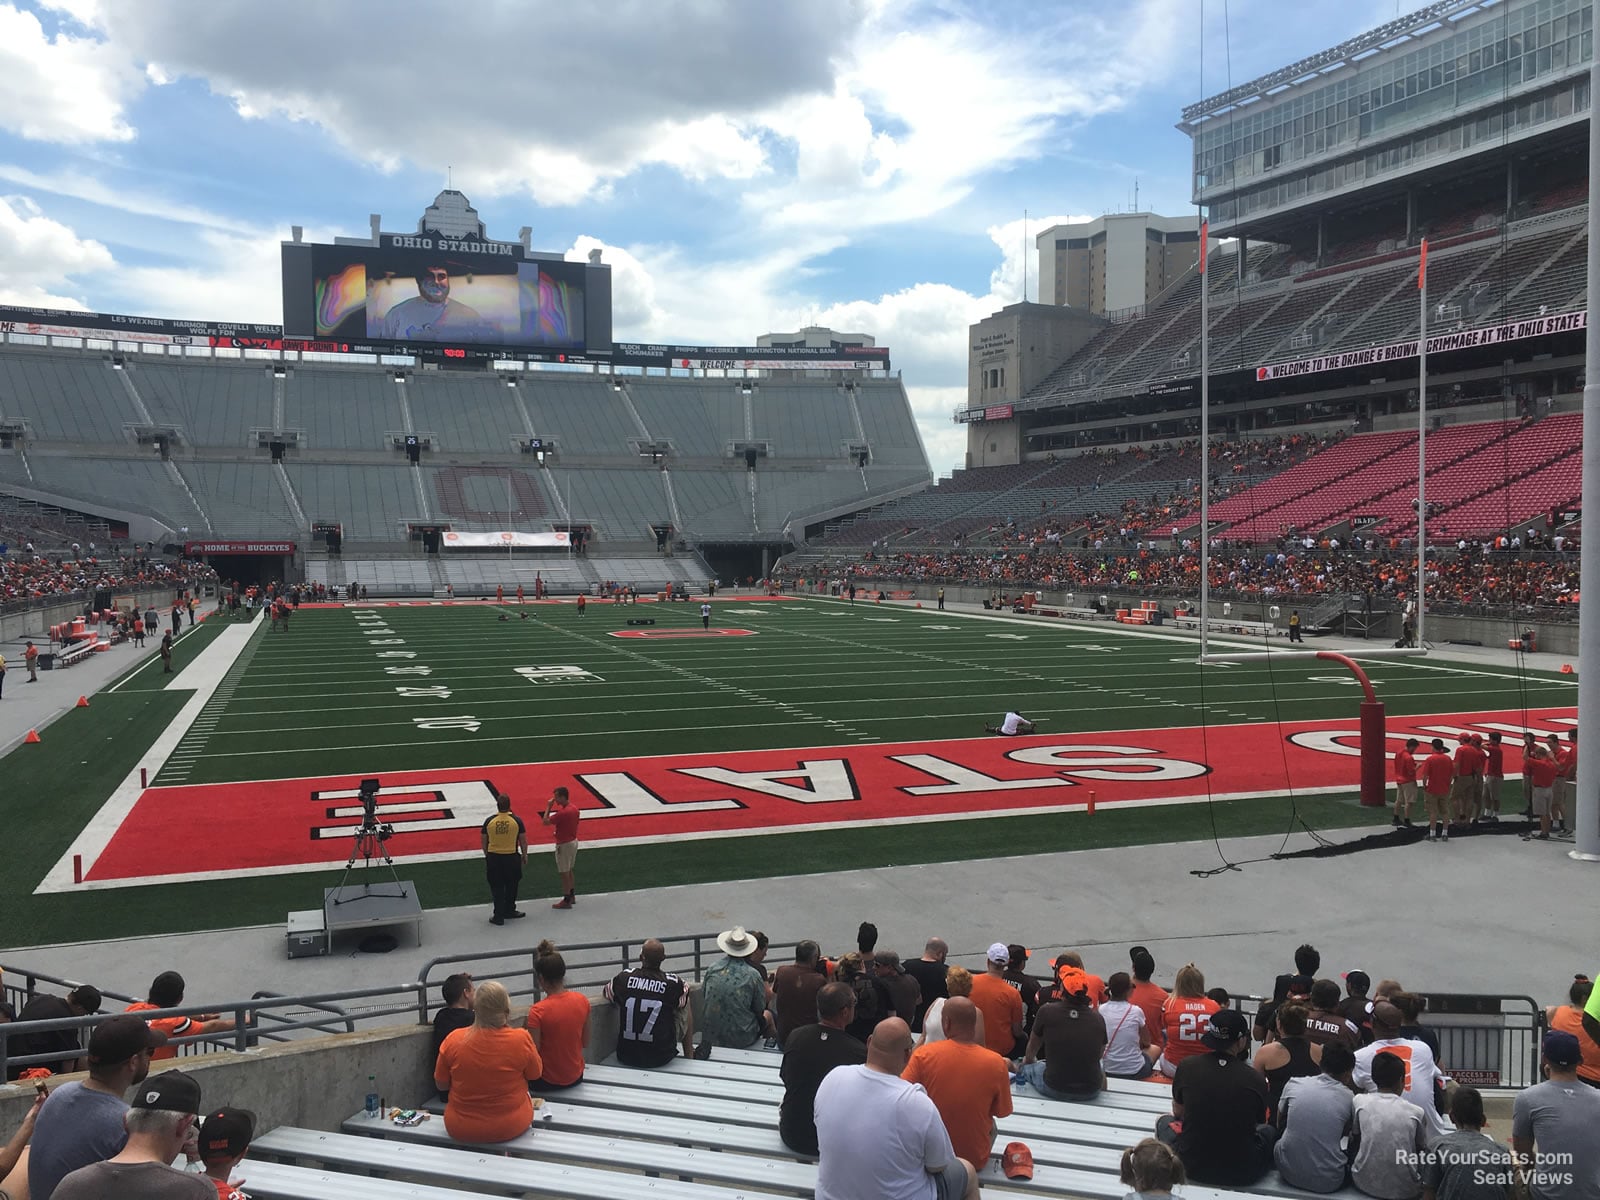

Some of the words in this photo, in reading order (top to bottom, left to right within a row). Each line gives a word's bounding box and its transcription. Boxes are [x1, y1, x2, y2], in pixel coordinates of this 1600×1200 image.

[392, 236, 433, 249] OHIO
[438, 239, 513, 256] STADIUM
[128, 317, 164, 326] WEXNER
[173, 321, 207, 329] HARMON
[217, 323, 249, 331] COVELLI
[254, 325, 280, 333] WELLS
[189, 328, 216, 336] WOLFE
[1272, 359, 1309, 378] WELCOME
[1312, 358, 1322, 371] TO
[1325, 356, 1339, 368] THE
[1341, 349, 1375, 367] ORANGE
[1376, 349, 1383, 361] &
[1385, 341, 1418, 360] BROWN
[1426, 332, 1479, 353] CRIMMAGE
[1480, 329, 1494, 343] AT
[1496, 324, 1515, 341] THE
[1517, 318, 1544, 338] OHIO
[1546, 312, 1580, 333] STATE
[700, 360, 736, 369] WELCOME
[204, 544, 230, 552] HOME
[247, 544, 290, 552] BUCKEYES
[627, 977, 667, 994] EDWARDS
[623, 997, 663, 1042] 17
[1315, 1020, 1340, 1034] PLAYER
